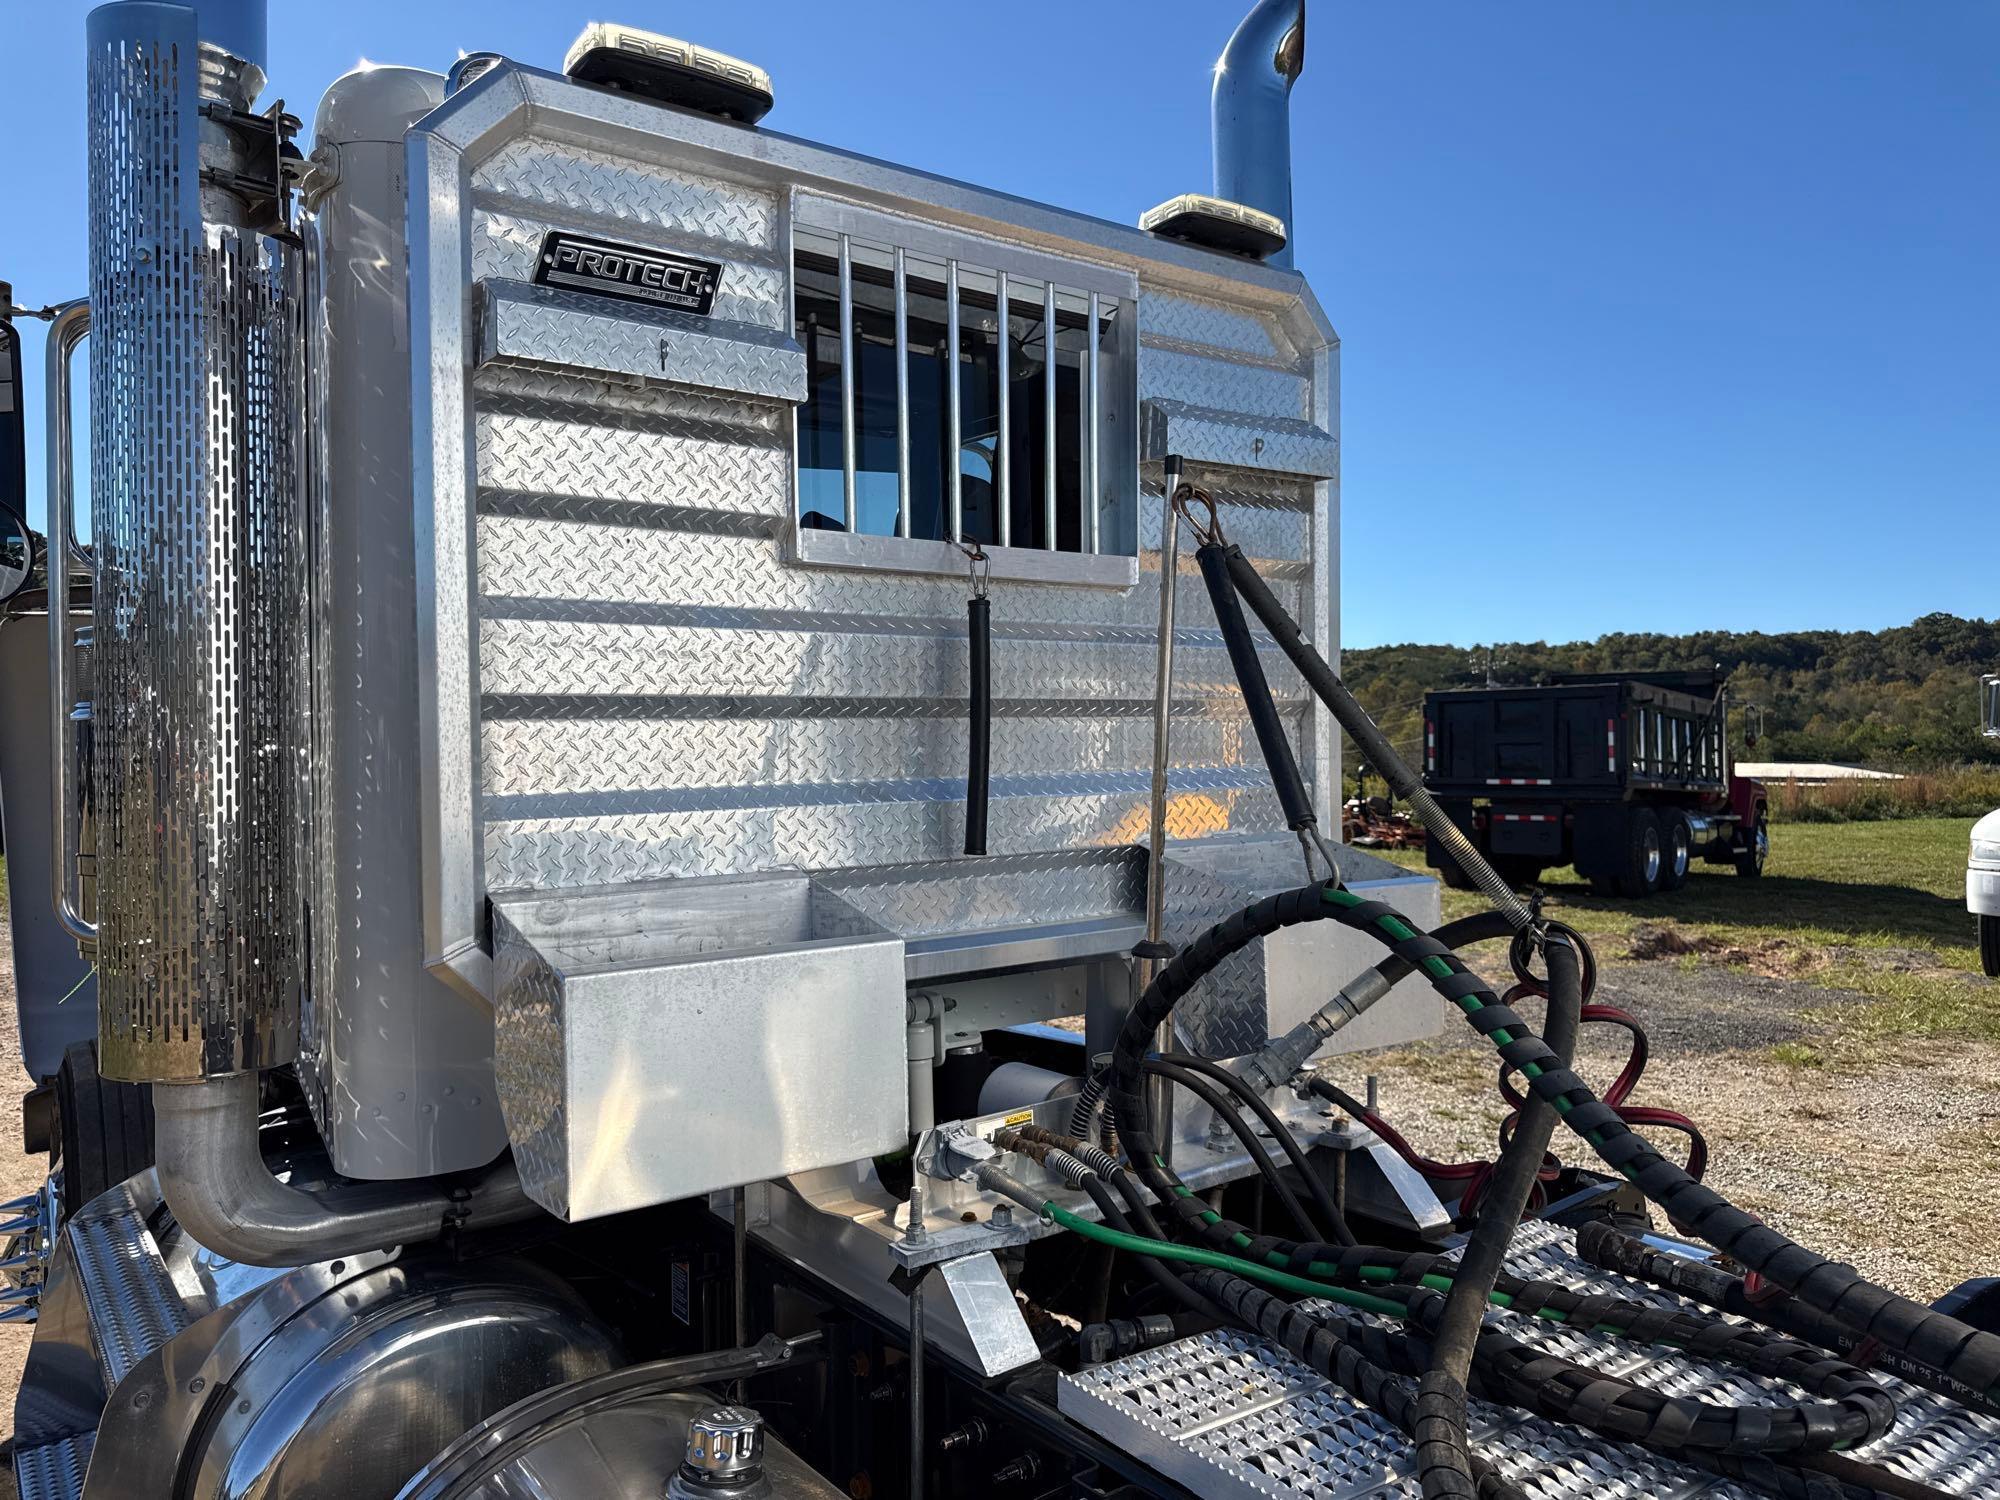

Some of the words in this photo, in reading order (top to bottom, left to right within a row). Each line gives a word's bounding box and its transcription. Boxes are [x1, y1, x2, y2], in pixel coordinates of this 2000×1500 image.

[551, 245, 707, 295] PROTECH
[1009, 1112, 1032, 1121] CAUTION
[1838, 1335, 1853, 1349] EN
[1881, 1352, 1896, 1366] SH
[1900, 1359, 1917, 1374] DN
